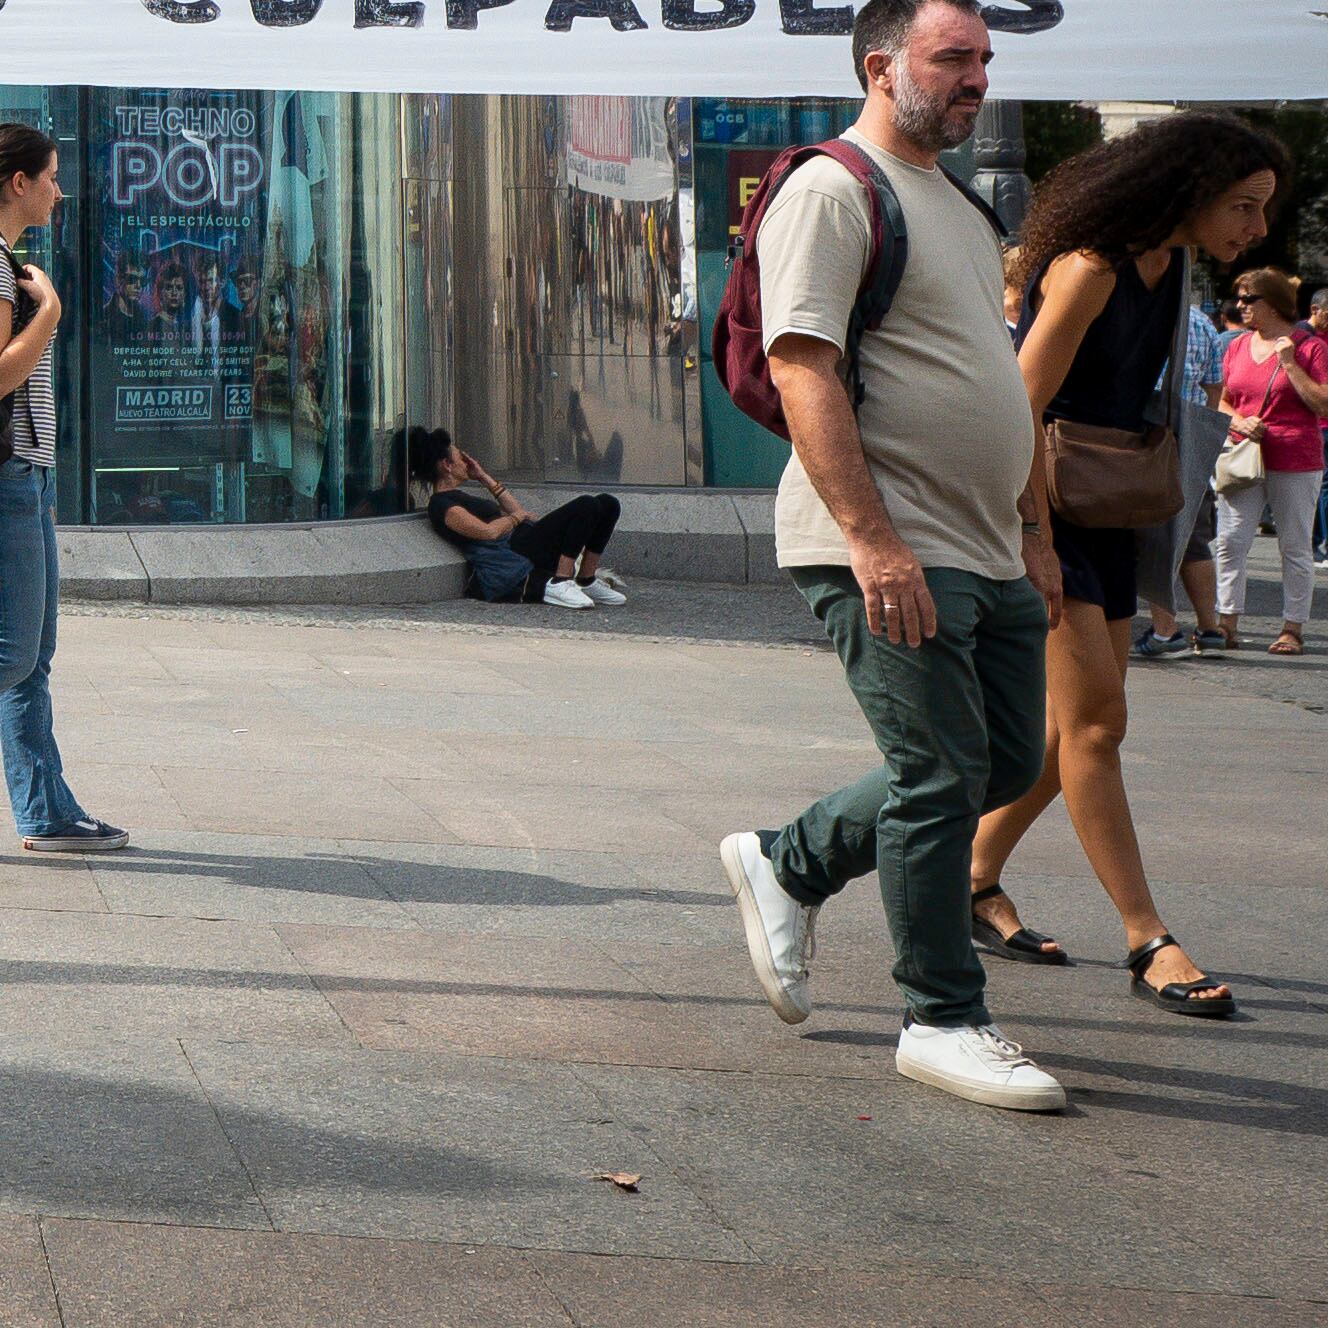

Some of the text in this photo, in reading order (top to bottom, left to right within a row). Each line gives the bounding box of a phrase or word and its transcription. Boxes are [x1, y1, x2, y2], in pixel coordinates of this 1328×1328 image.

[116, 106, 255, 137] TECHNO
[715, 114, 745, 124] OCB
[113, 142, 264, 207] POP
[739, 177, 761, 208] E
[127, 213, 251, 227] EL ESPECTÁCULO
[113, 347, 151, 355] DEPECHE
[123, 370, 147, 378] DAVID
[125, 388, 251, 406] MADRID 23
[118, 409, 143, 418] NUEVO
[144, 407, 176, 417] TEATRO
[228, 405, 251, 415] NOV
